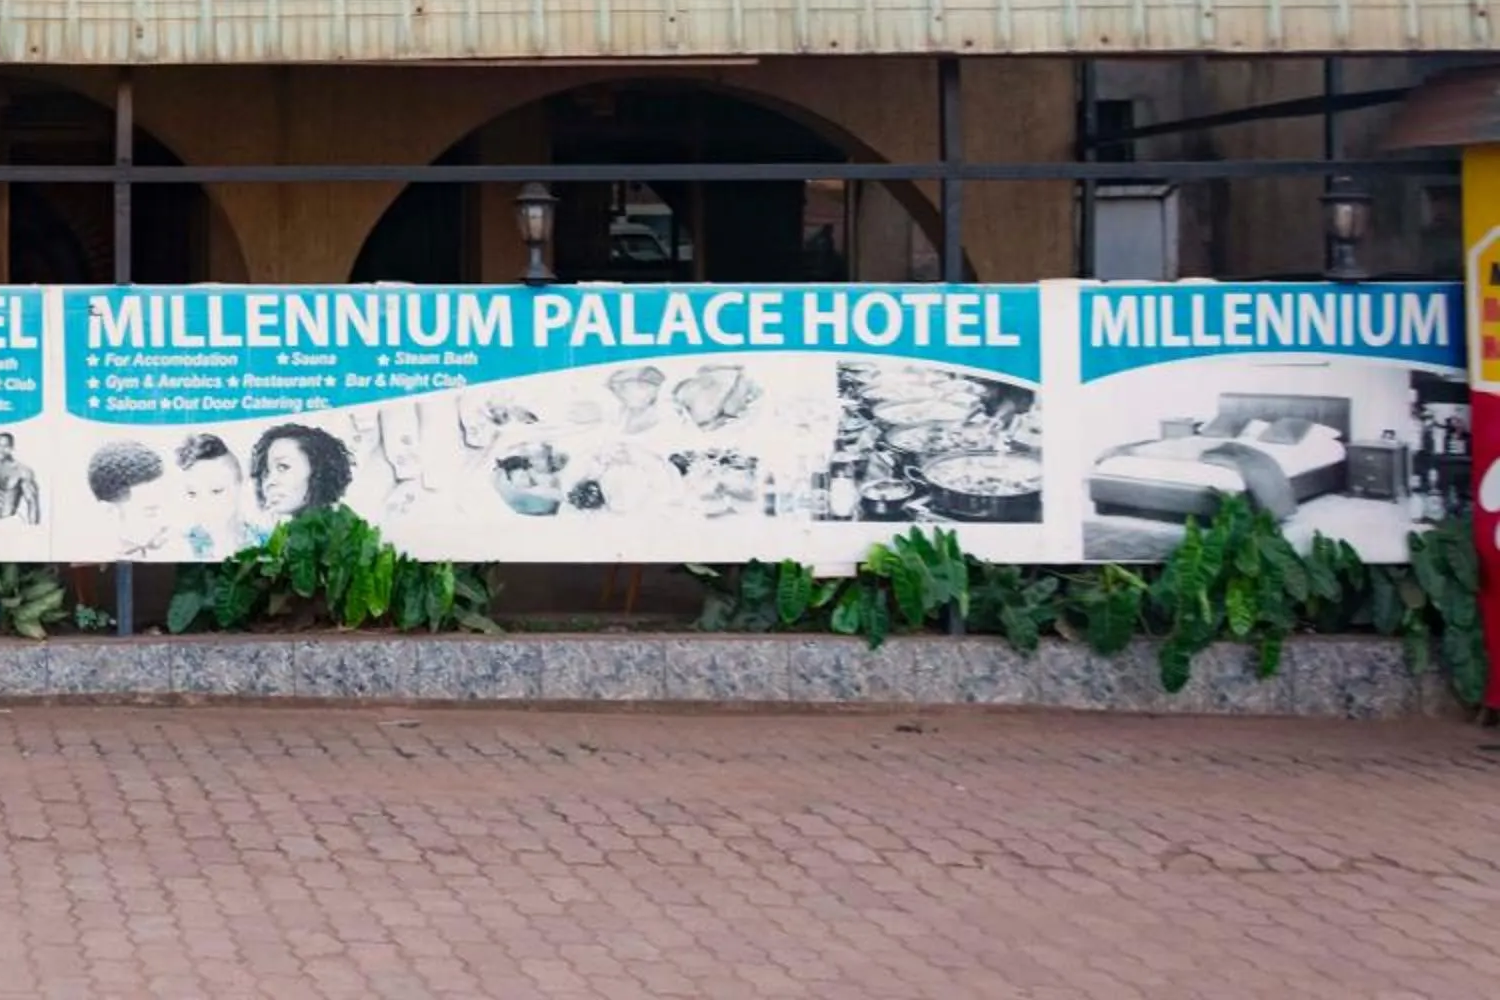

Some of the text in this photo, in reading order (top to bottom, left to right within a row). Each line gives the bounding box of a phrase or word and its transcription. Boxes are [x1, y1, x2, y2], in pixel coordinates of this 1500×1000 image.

[88, 291, 1020, 348] MILLENNIUM PALACE HOTEL
[1091, 292, 1448, 346] MILLENNIUM
[104, 353, 130, 367] For
[291, 352, 337, 366] Sauna
[395, 352, 440, 366] Steam
[443, 352, 479, 366] Bath
[3, 378, 37, 391] Club
[105, 374, 140, 392] Gym
[143, 374, 155, 388] &
[243, 373, 323, 388] Restaurant
[345, 373, 372, 388] Bar
[374, 373, 387, 388] &
[388, 373, 429, 391] Night
